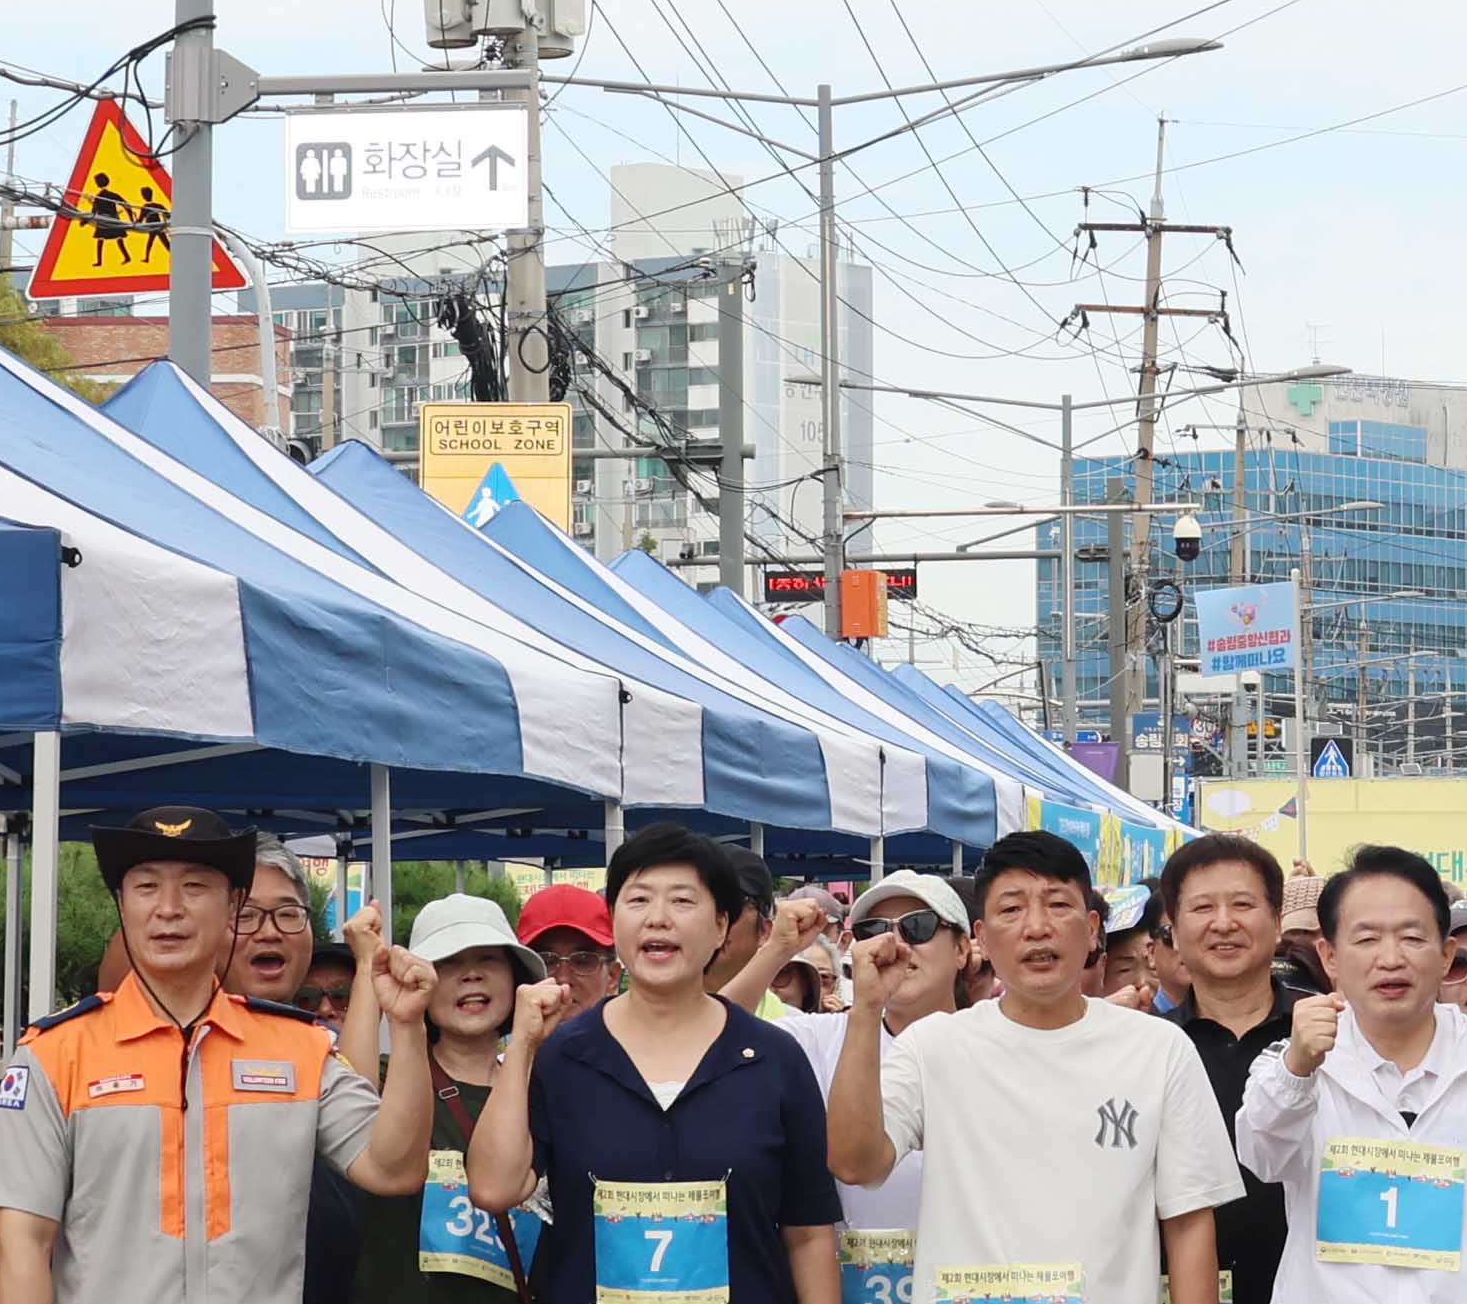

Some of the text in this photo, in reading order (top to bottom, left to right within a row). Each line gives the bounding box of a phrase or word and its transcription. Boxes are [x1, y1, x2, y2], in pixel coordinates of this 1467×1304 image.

[364, 141, 460, 179] 화장실
[435, 420, 558, 436] 어린이보호구역
[439, 439, 554, 449] SCHOOL ZONE
[1095, 1099, 1138, 1148] NY
[1380, 1187, 1397, 1227] 1
[645, 1230, 673, 1271] 7
